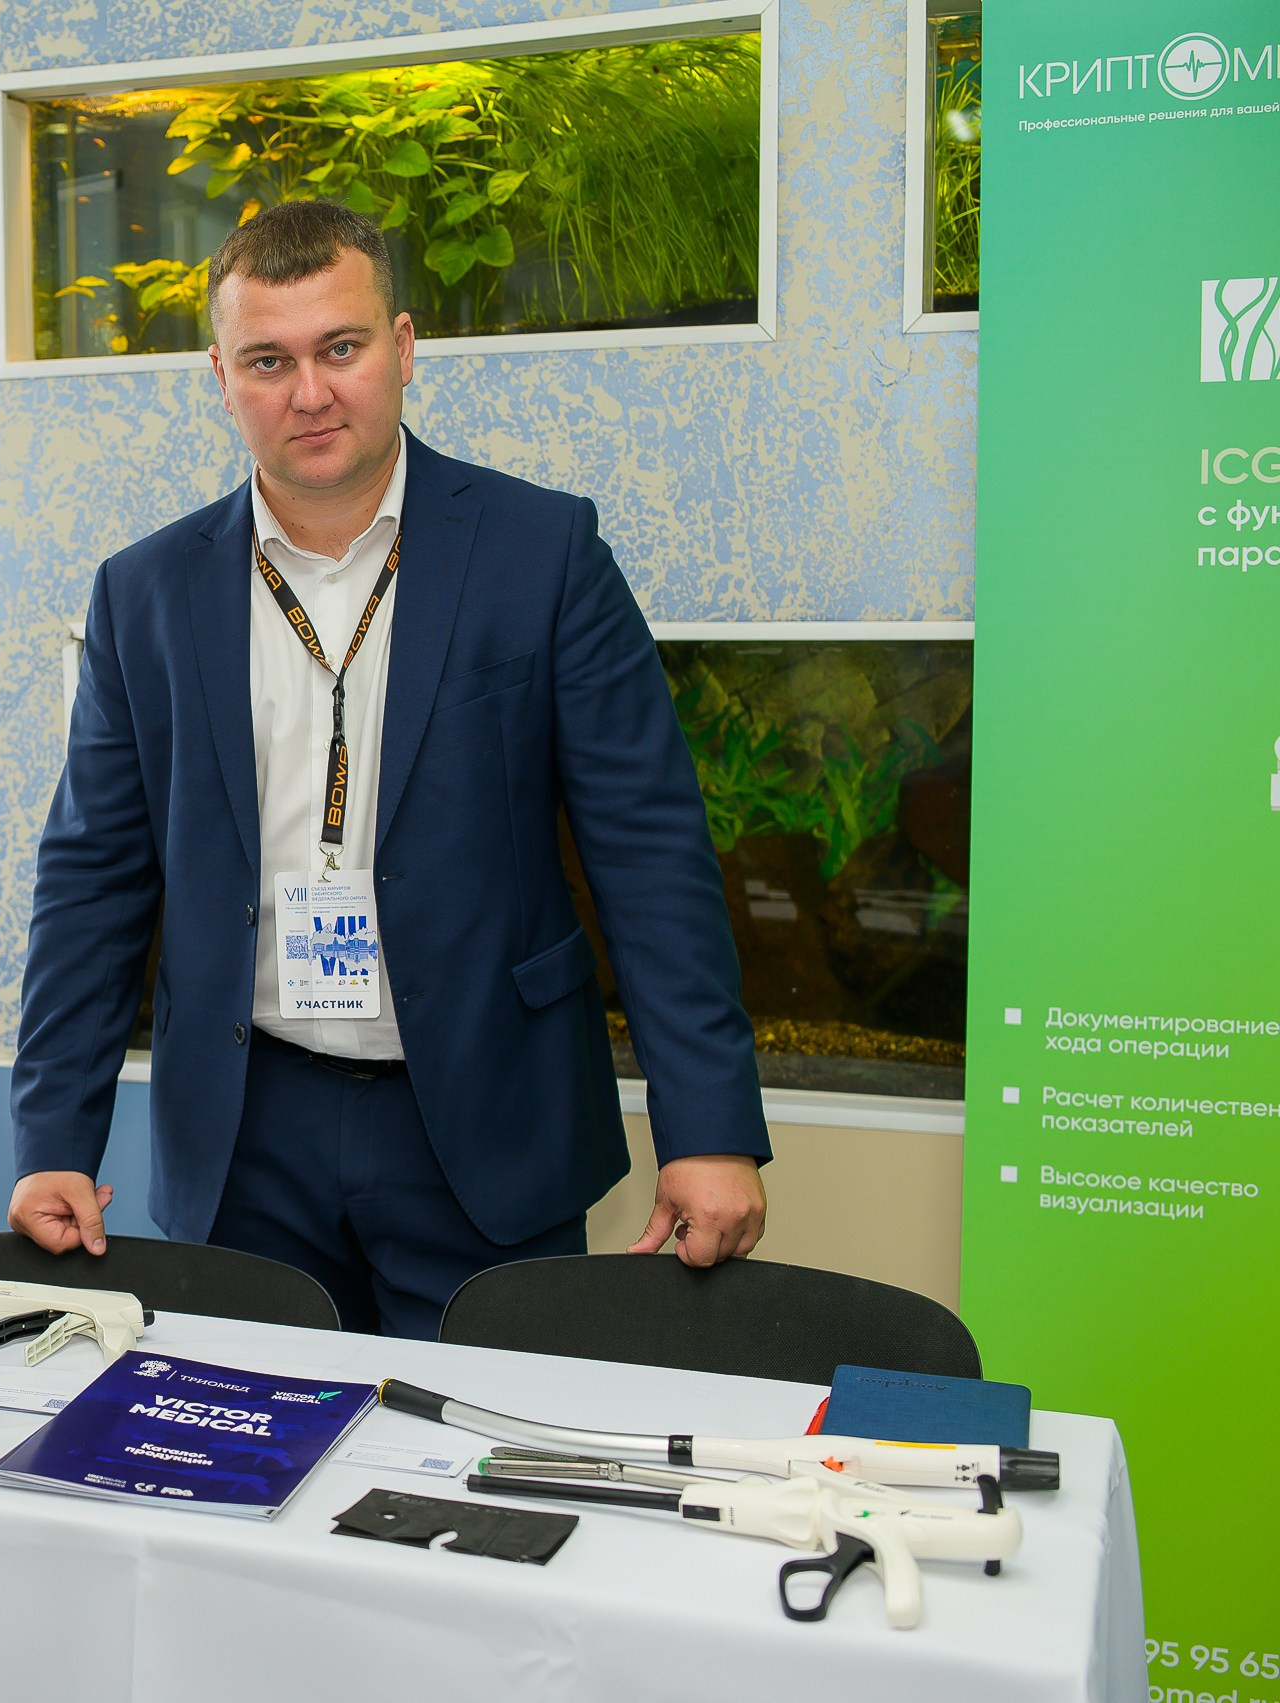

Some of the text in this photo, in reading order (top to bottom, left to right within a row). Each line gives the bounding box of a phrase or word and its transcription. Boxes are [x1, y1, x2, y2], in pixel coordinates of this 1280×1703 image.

[1018, 101, 1280, 132] Профессиональные решения для вашей
[1197, 506, 1217, 526] с
[343, 594, 380, 669] BOWA
[327, 745, 347, 827] BOWA
[284, 887, 307, 902] VIII
[295, 1000, 363, 1009] УЧАСТНИК
[1045, 1006, 1280, 1036] Документирование
[1045, 1035, 1230, 1060] хода операции
[1042, 1086, 1125, 1108] Расчет
[1041, 1114, 1193, 1138] показателей
[1040, 1165, 1259, 1198] Высокое качество
[1039, 1193, 1204, 1220] визуализации
[180, 1374, 251, 1394] ТРИОМЕД
[274, 1391, 316, 1400] VICTOR
[155, 1394, 273, 1425] VICTOR
[270, 1394, 321, 1405] MEDICAL
[128, 1403, 272, 1438] MEDICAL
[124, 1446, 214, 1467] продукции
[140, 1442, 208, 1460] Каталог
[1144, 1638, 1280, 1680] 95 95 65
